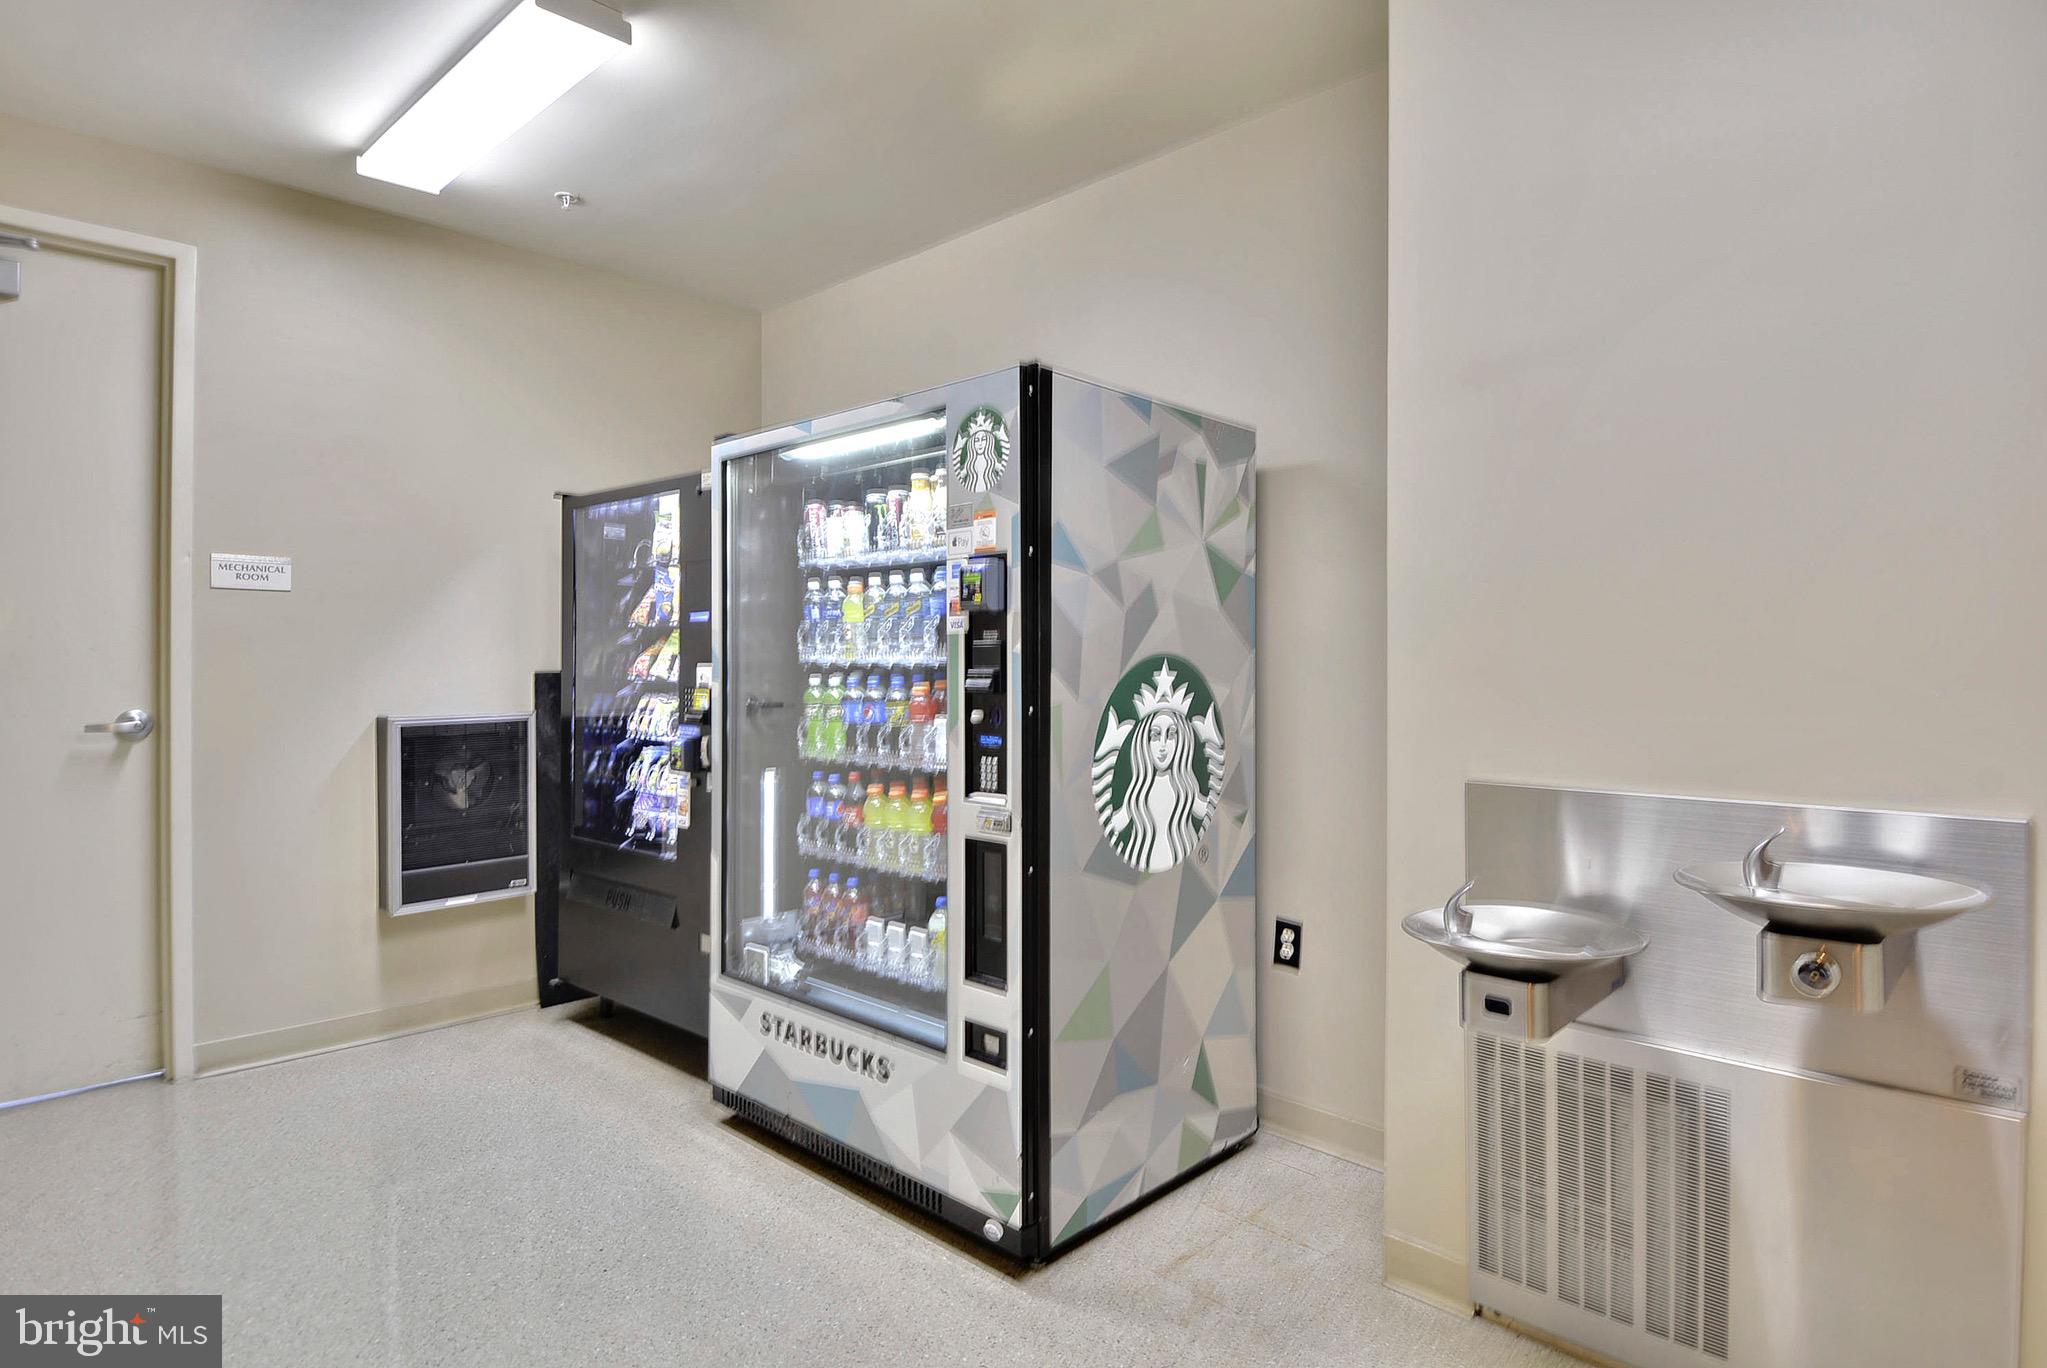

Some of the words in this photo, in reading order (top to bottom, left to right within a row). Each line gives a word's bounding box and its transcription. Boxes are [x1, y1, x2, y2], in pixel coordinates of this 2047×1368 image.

[218, 563, 286, 574] MECHANICAL
[235, 572, 269, 582] ROOM
[949, 620, 964, 629] VISA
[759, 1011, 891, 1084] STARBUCKS
